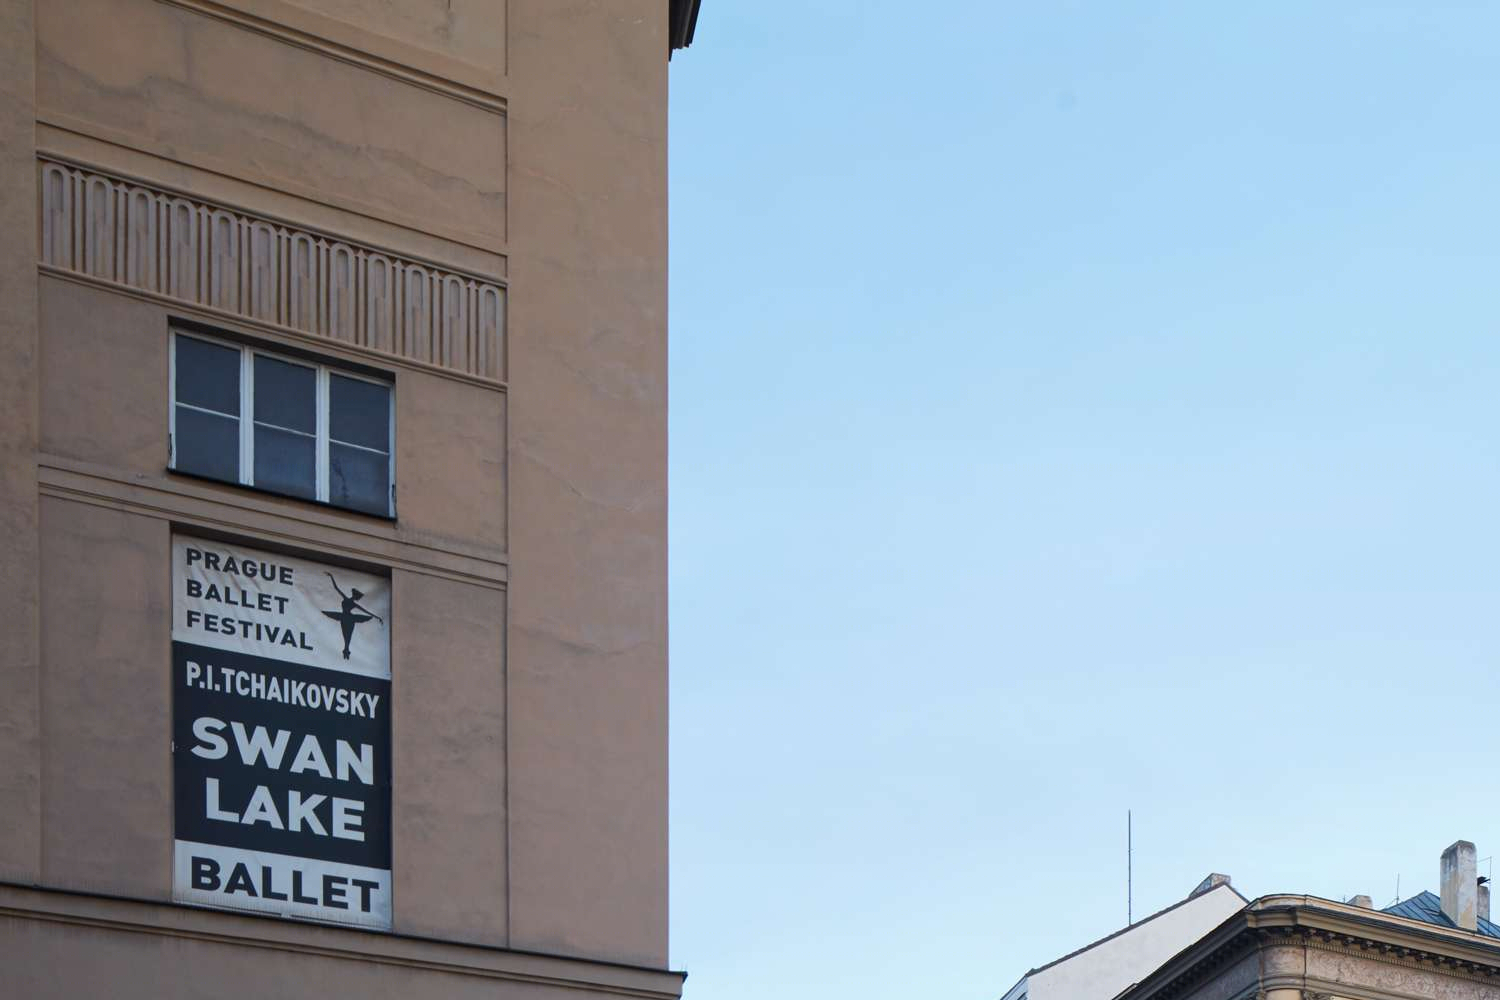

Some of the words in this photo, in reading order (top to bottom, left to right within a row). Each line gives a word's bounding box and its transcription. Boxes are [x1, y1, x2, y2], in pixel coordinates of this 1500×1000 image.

[186, 548, 294, 585] PRAGUE
[186, 579, 289, 614] BALLET
[187, 610, 313, 651] FESTIVAL
[185, 661, 379, 719] P.I.TCHAIKOVSKY
[191, 717, 374, 785] SWAN
[206, 777, 365, 842] LAKE
[191, 856, 379, 913] BALLET
